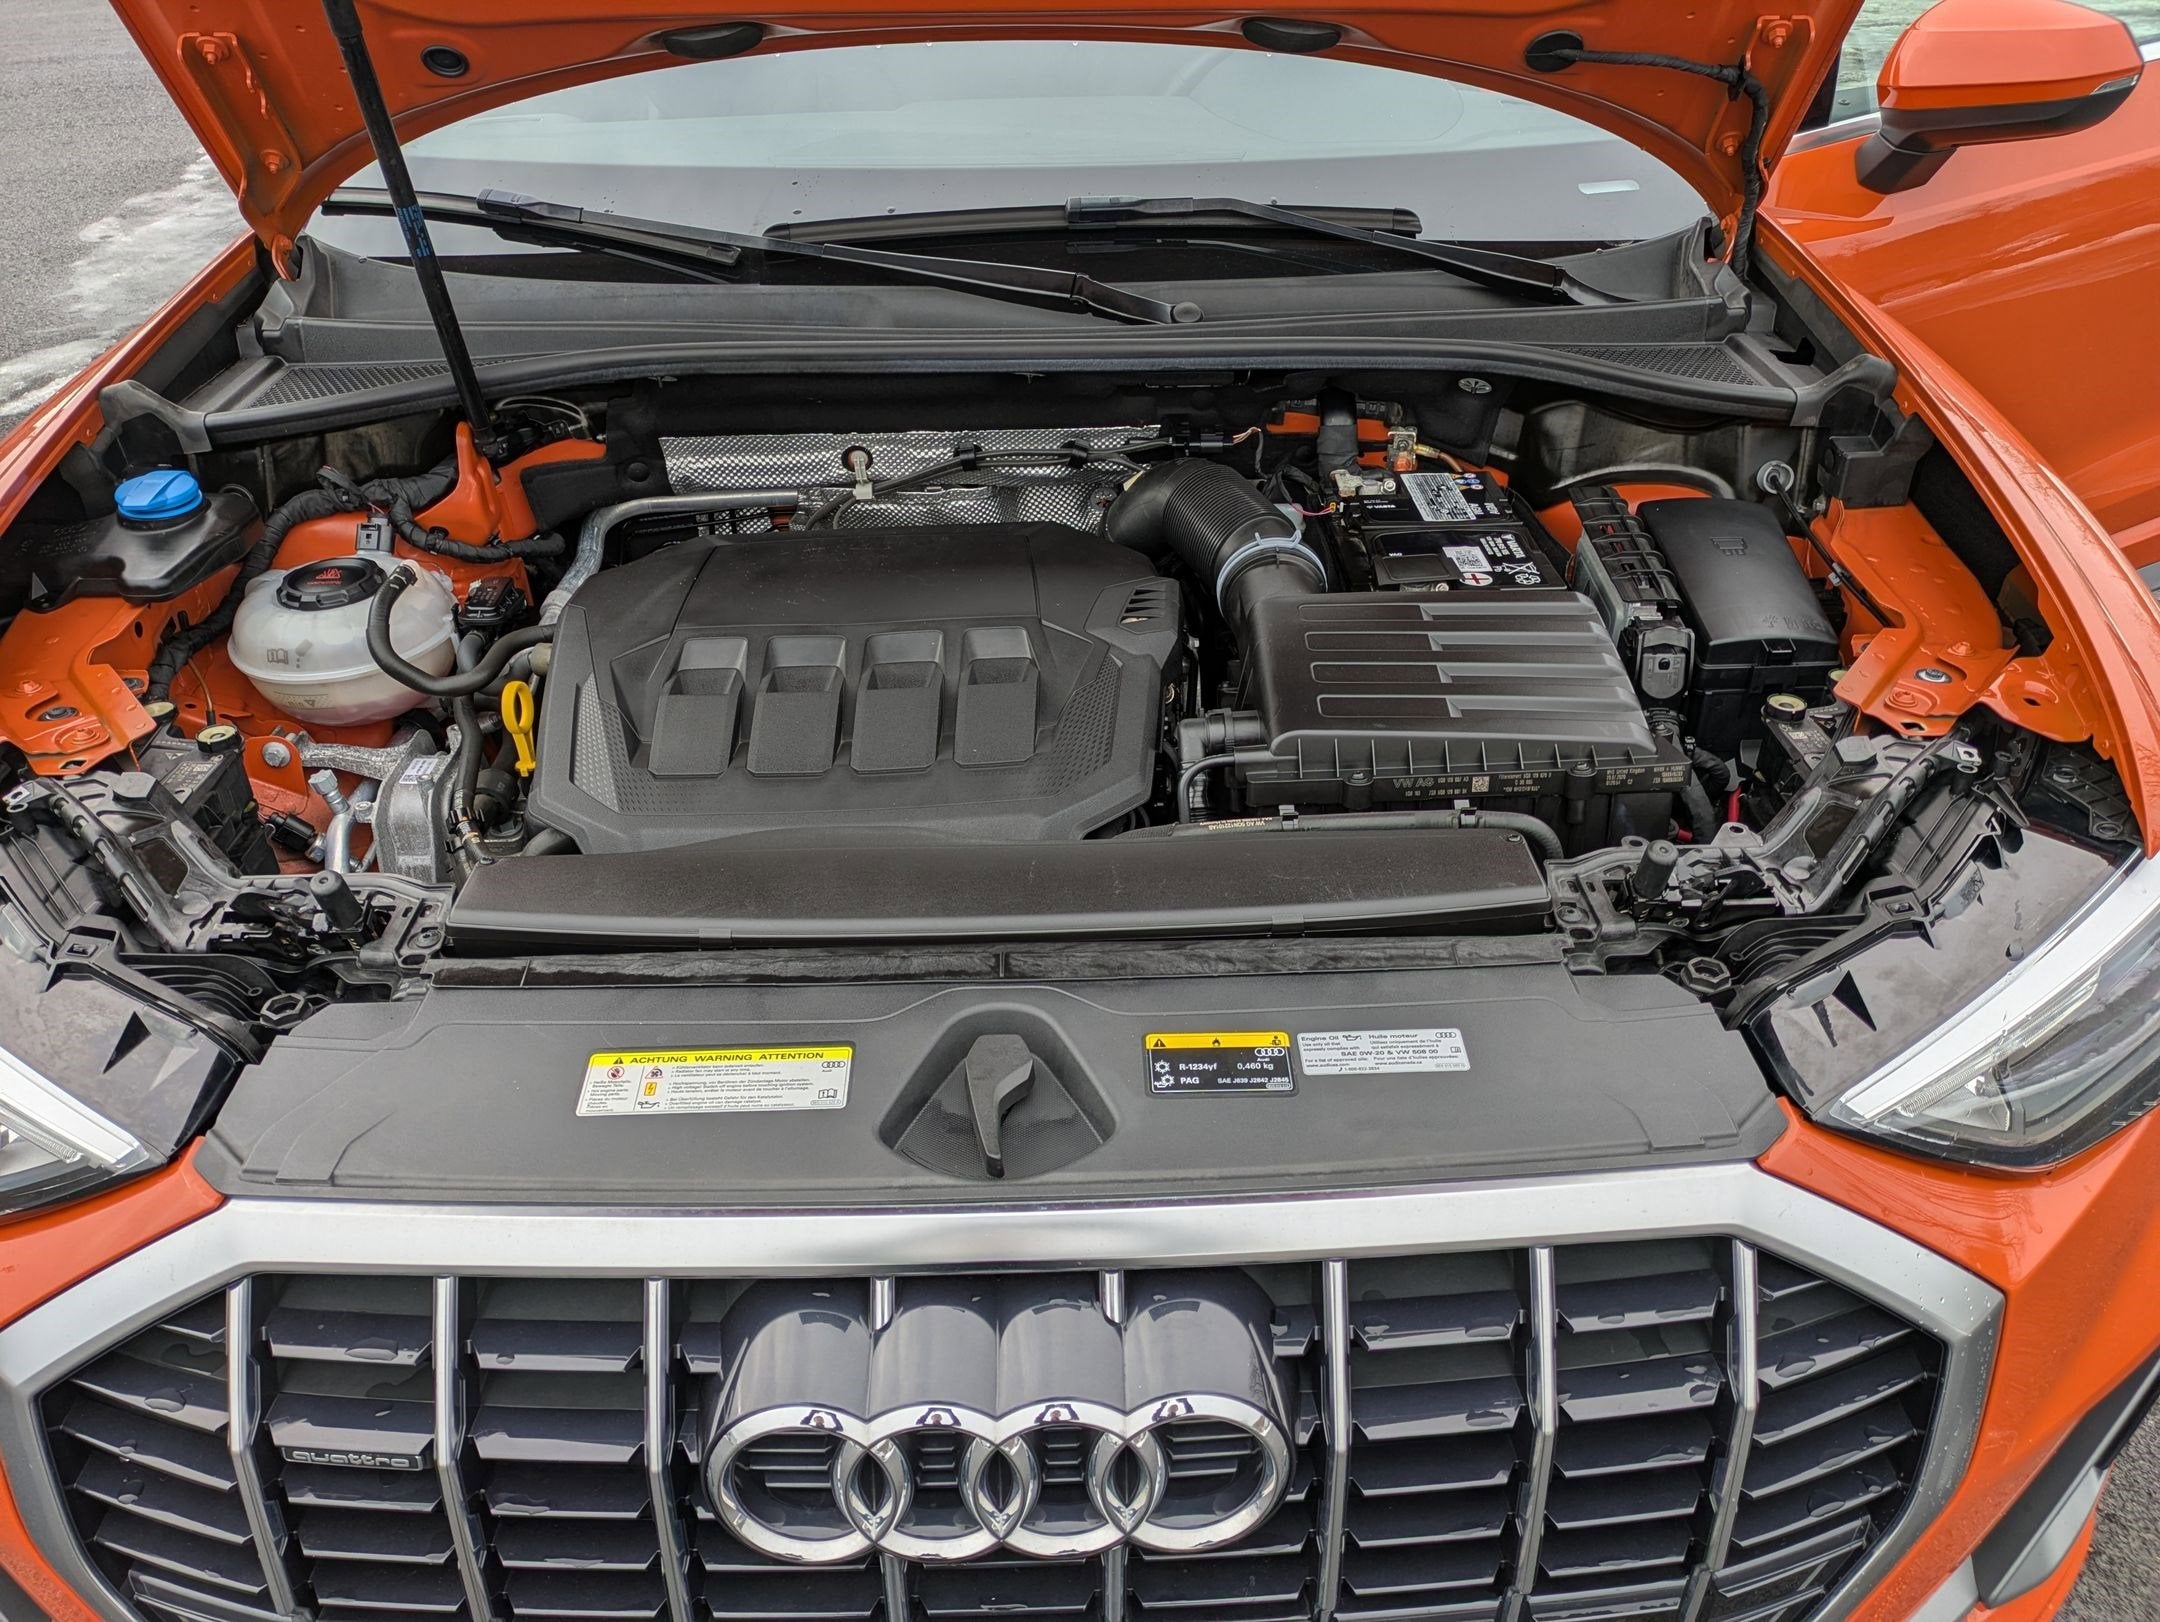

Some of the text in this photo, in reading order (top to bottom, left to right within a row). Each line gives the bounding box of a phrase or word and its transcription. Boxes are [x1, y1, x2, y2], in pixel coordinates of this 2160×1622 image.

[630, 1052, 824, 1064] ACHTUNG WARNING ATTENTION
[1179, 1062, 1218, 1071] R-1234yf
[1263, 1062, 1274, 1071] kg
[1180, 1076, 1200, 1085] PAG
[291, 1450, 410, 1468] quattro
